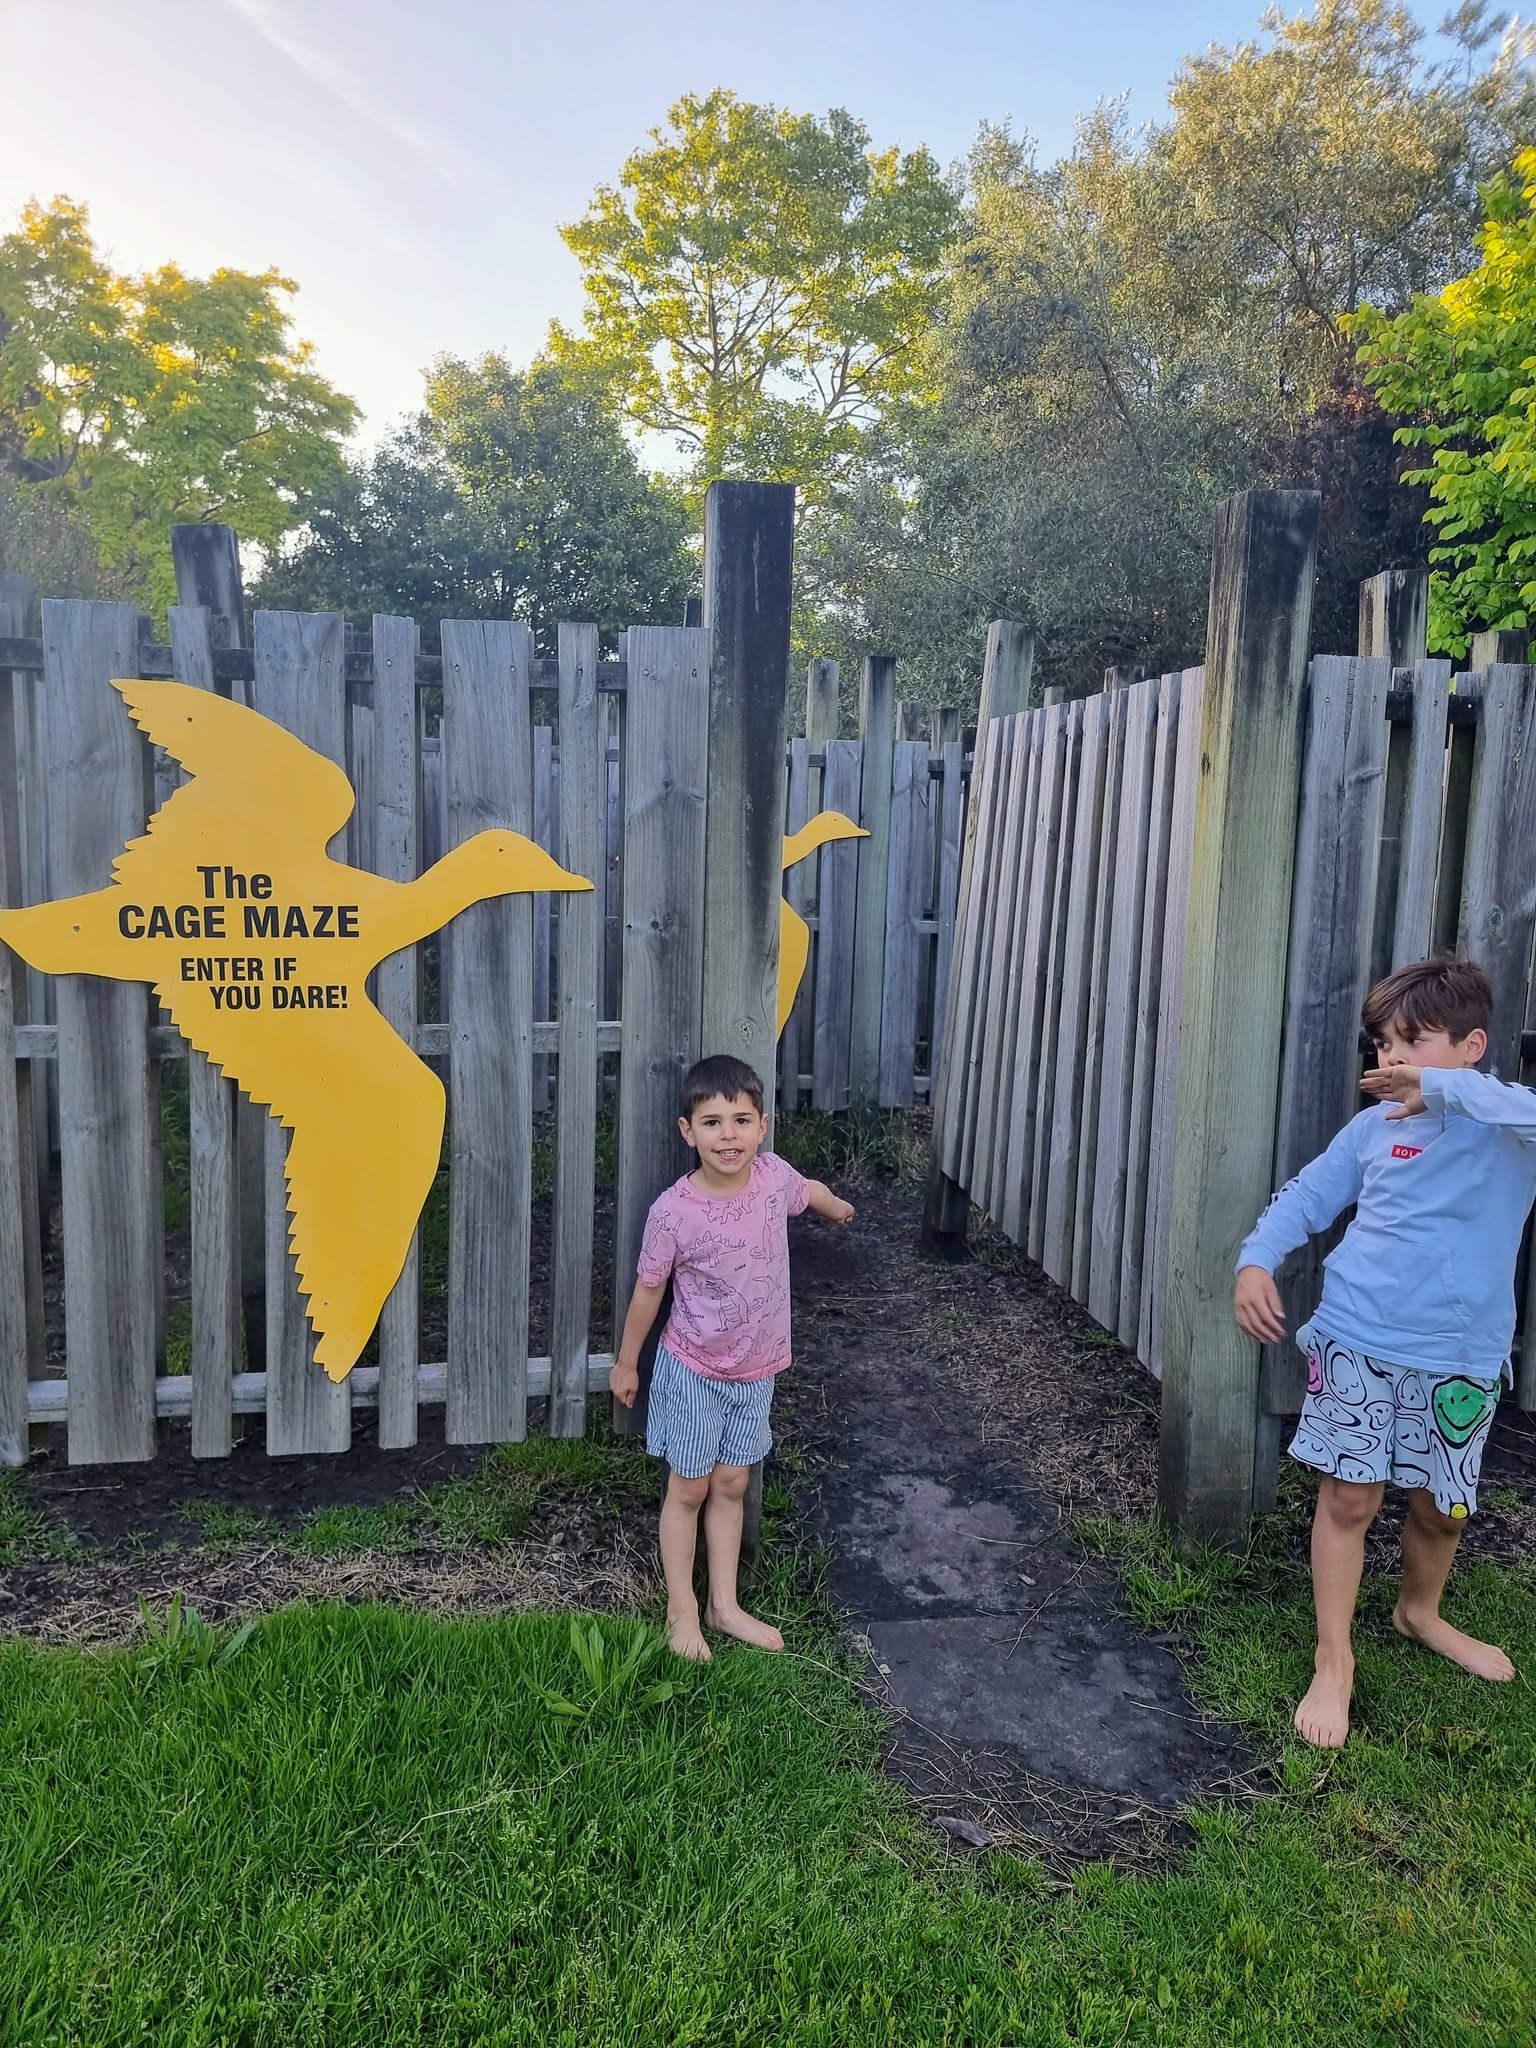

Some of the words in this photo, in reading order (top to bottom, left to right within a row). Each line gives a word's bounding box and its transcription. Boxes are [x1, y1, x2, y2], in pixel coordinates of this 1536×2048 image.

[197, 866, 273, 899] The
[119, 905, 226, 939] CAGE
[244, 905, 360, 938] MAZE
[181, 957, 264, 981] ENTER
[275, 957, 297, 981] IF
[210, 985, 261, 1010] YOU
[273, 985, 348, 1009] DARE!
